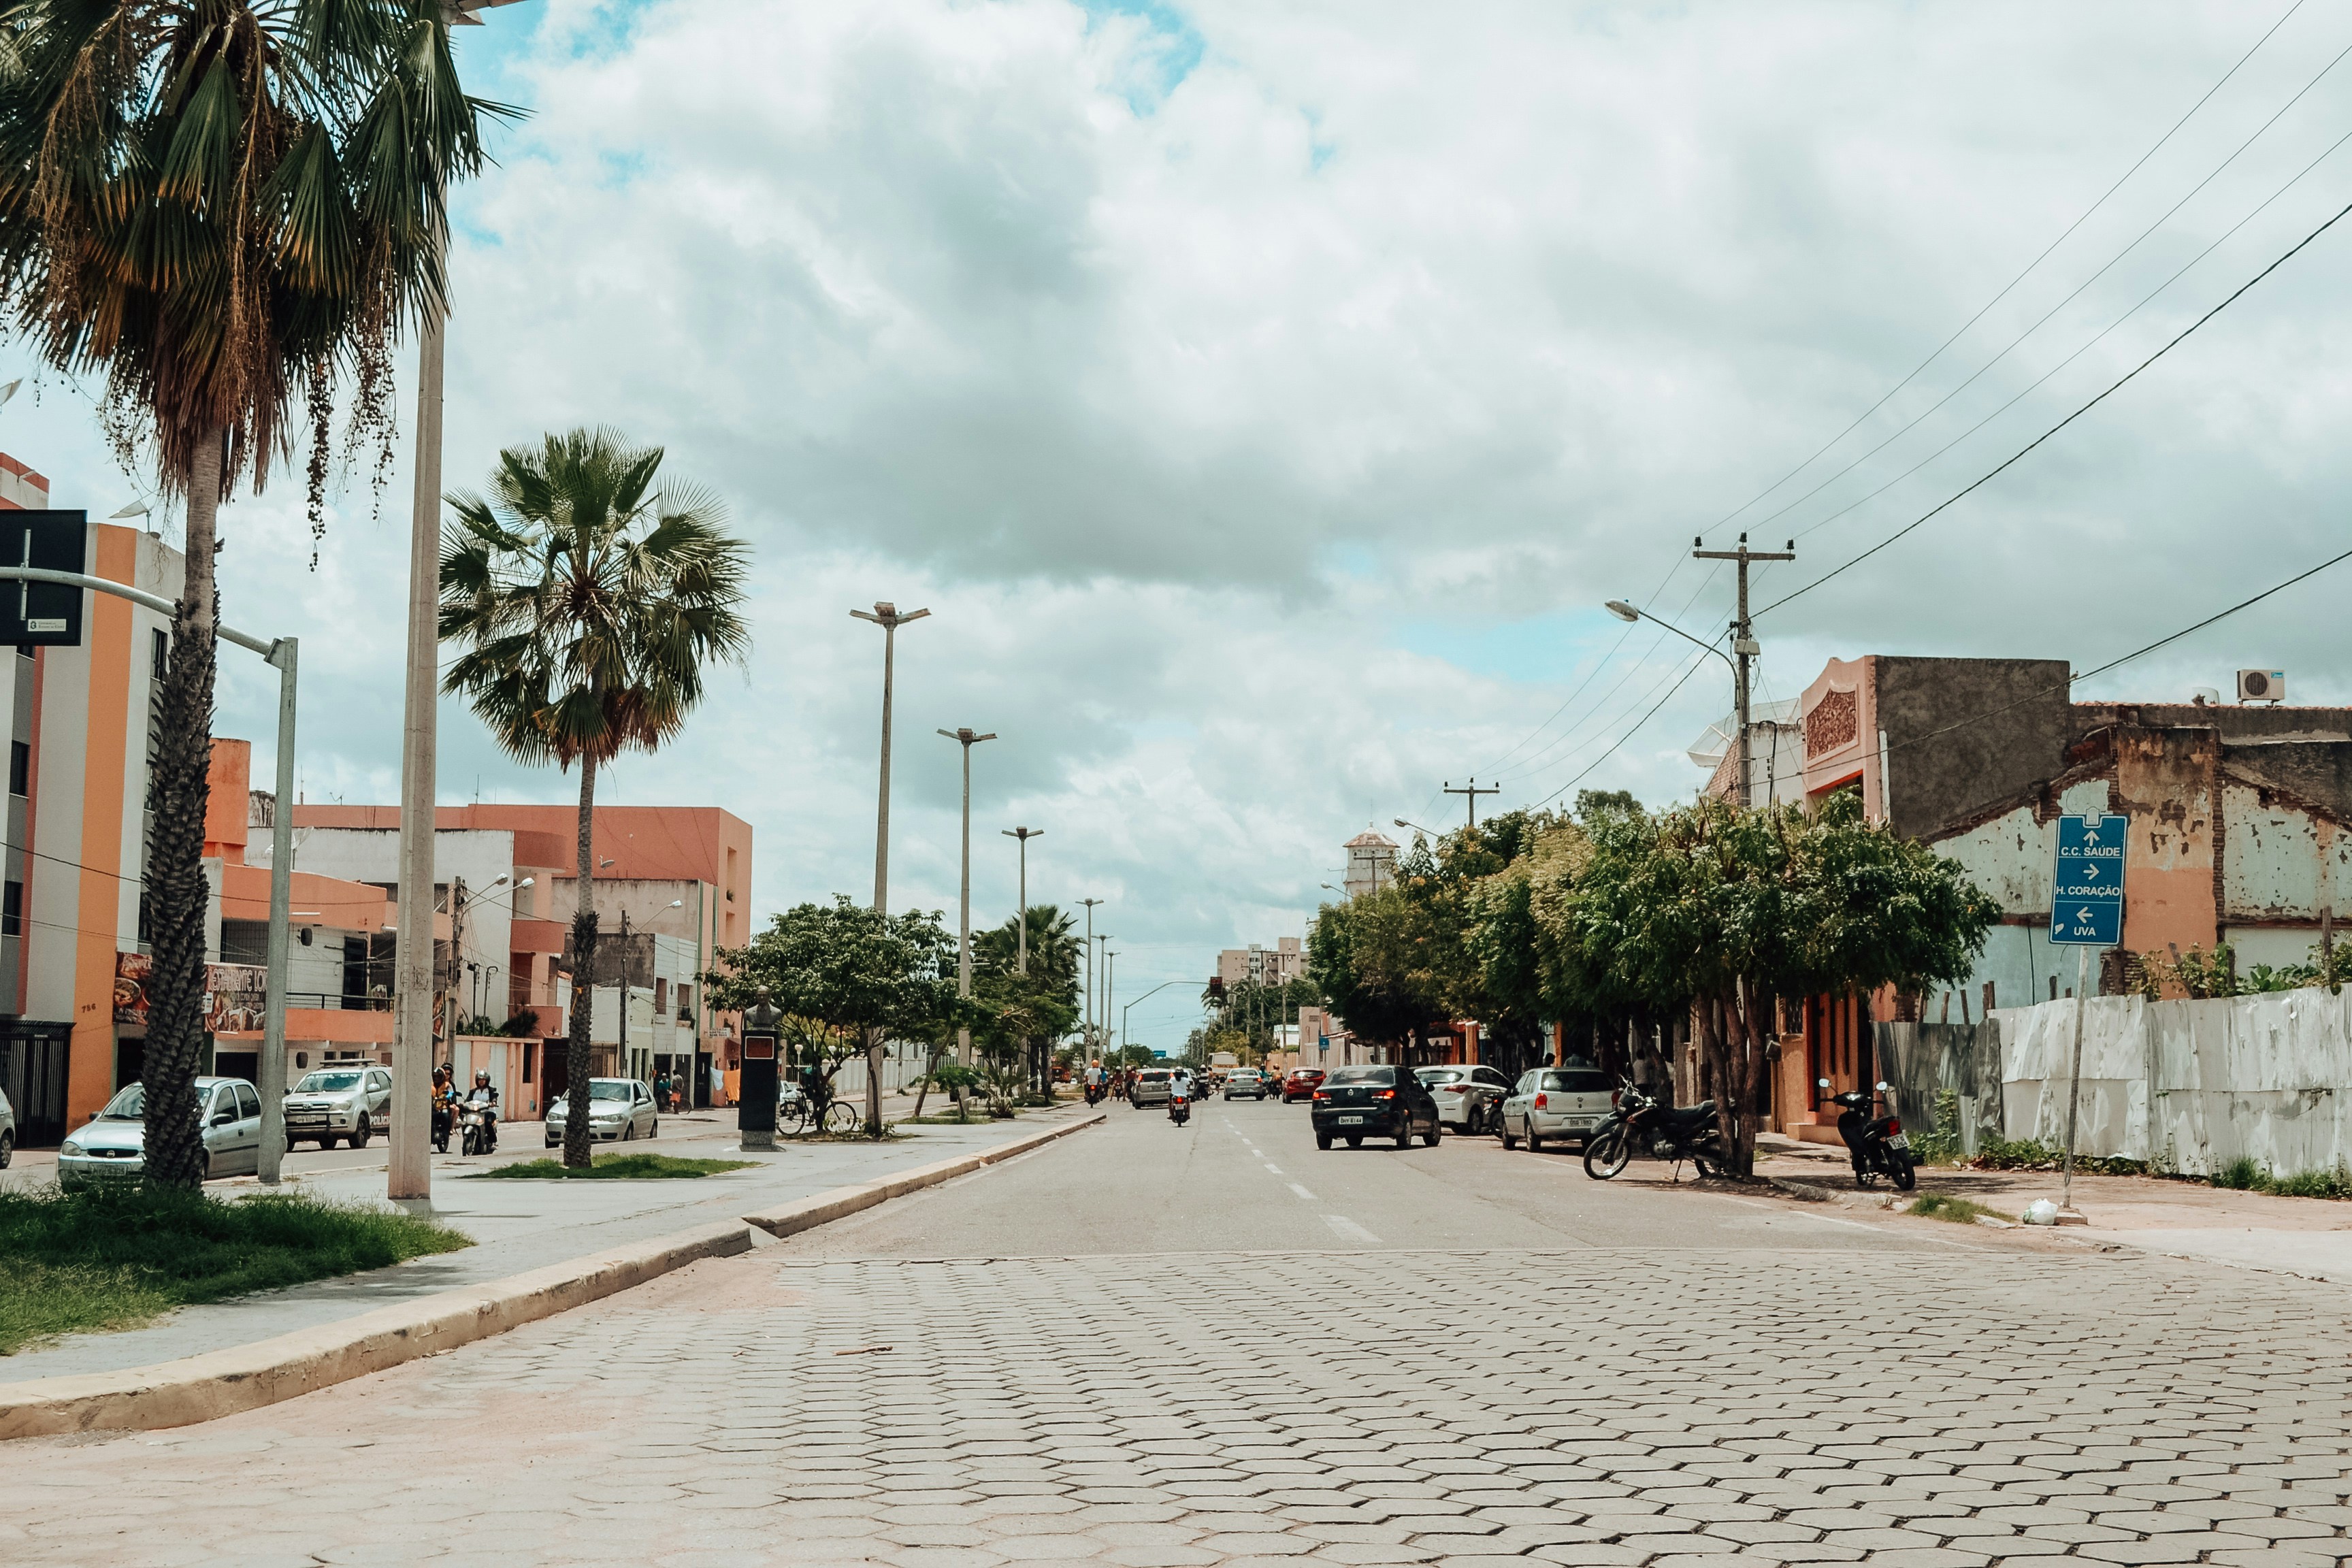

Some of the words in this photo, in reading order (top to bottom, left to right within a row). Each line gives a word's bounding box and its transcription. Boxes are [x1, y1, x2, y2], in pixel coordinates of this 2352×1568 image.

[2061, 847, 2081, 856] C.C.
[2084, 845, 2121, 857] SAÚDE
[2056, 886, 2066, 895] H.
[2068, 885, 2121, 898] CORAÇÃO
[2074, 927, 2096, 936] UVA
